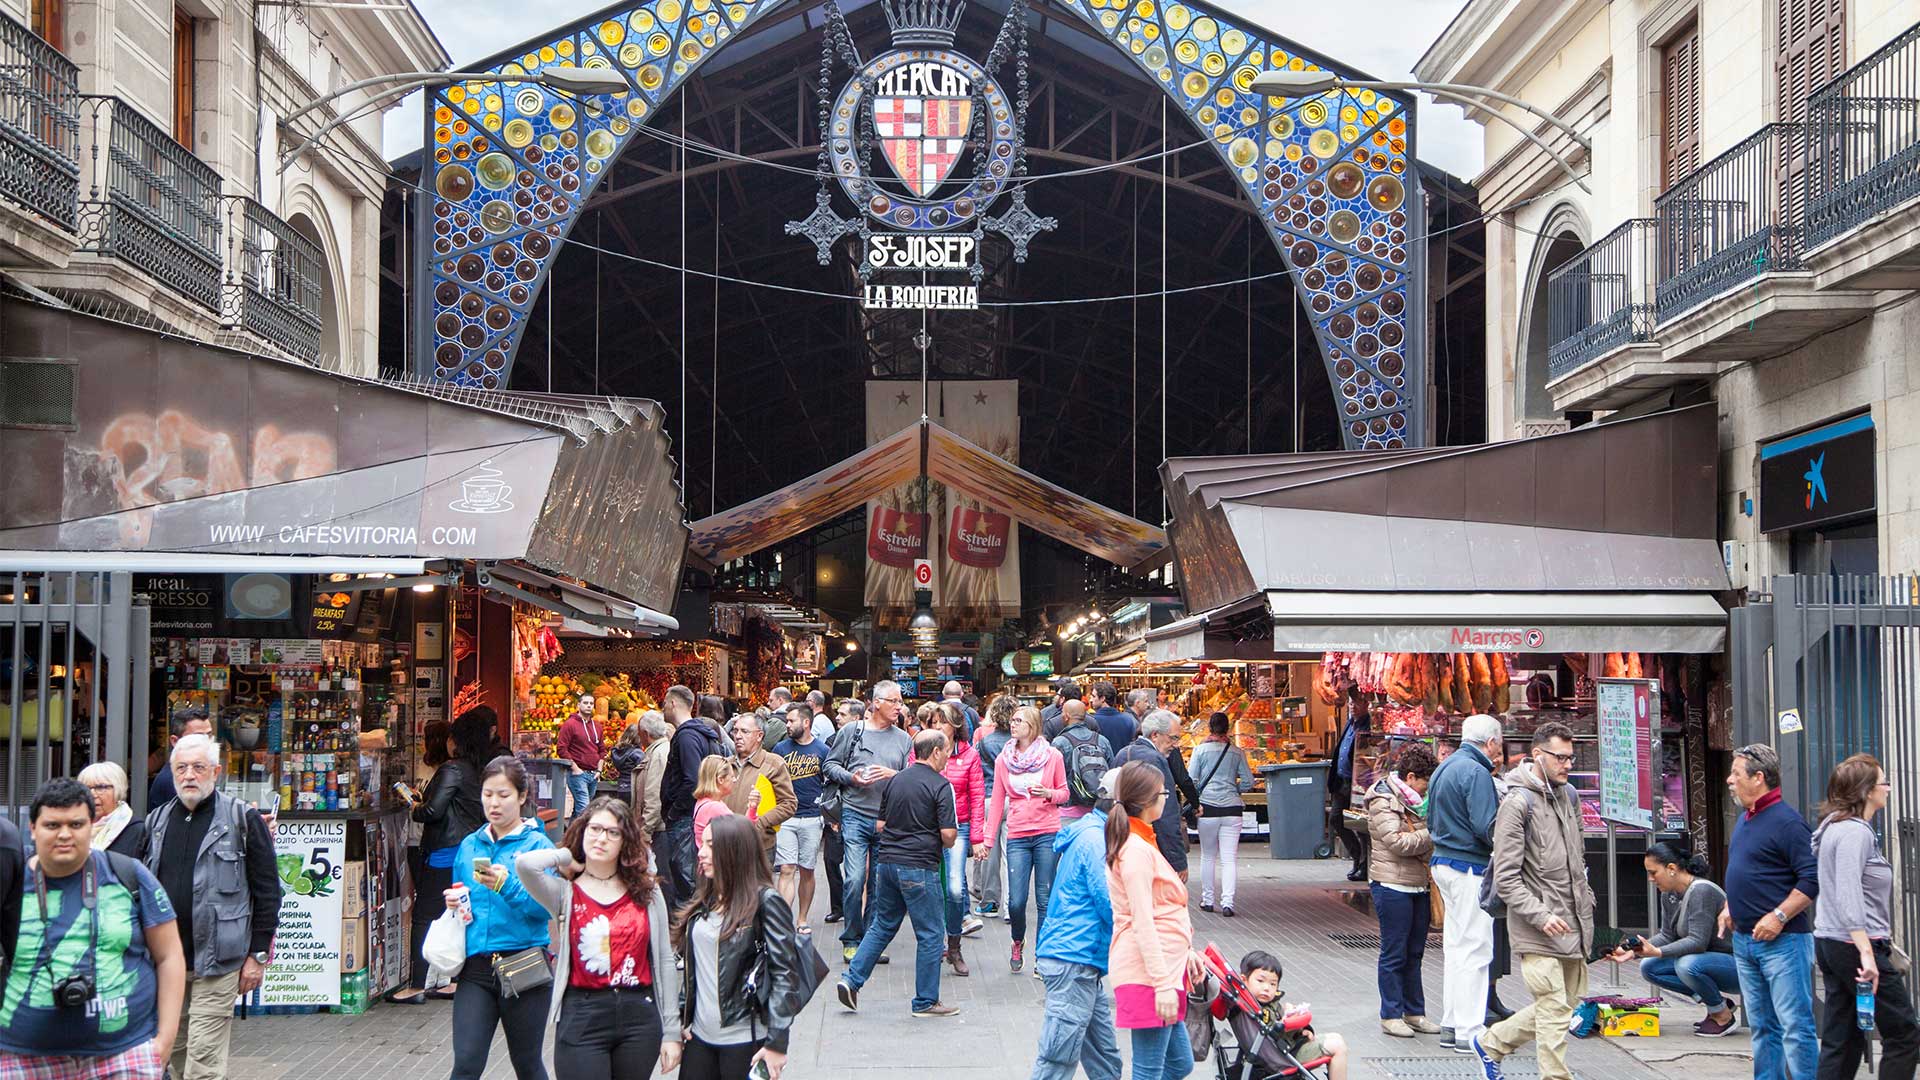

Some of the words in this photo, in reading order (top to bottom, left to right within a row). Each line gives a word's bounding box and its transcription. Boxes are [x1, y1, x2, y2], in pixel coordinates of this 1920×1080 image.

[877, 62, 970, 96] MERCAT
[893, 236, 975, 268] JOSEP
[864, 285, 887, 309] LA
[891, 285, 979, 310] BOQUERIA
[878, 528, 921, 548] Estrella
[958, 528, 1001, 548] Estrella
[920, 567, 928, 580] 6
[150, 592, 209, 606] PRESSO
[313, 607, 345, 619] BREAKFAST
[1451, 627, 1523, 645] Marcos
[278, 823, 344, 835] OCKTAILS
[282, 901, 299, 909] JITO
[279, 911, 312, 919] IPIRINHA
[278, 921, 313, 930] RGARITA
[275, 942, 290, 950] NHA
[292, 942, 326, 950] COLADA
[282, 952, 296, 960] ON
[298, 952, 311, 960] THE
[313, 952, 339, 960] BEACH
[285, 964, 324, 972] ALCOHOL
[264, 974, 296, 982] MOJITO
[264, 984, 310, 992] CAIPIRINHA
[263, 994, 280, 1002] SAN
[282, 994, 329, 1002] FRANCISCO
